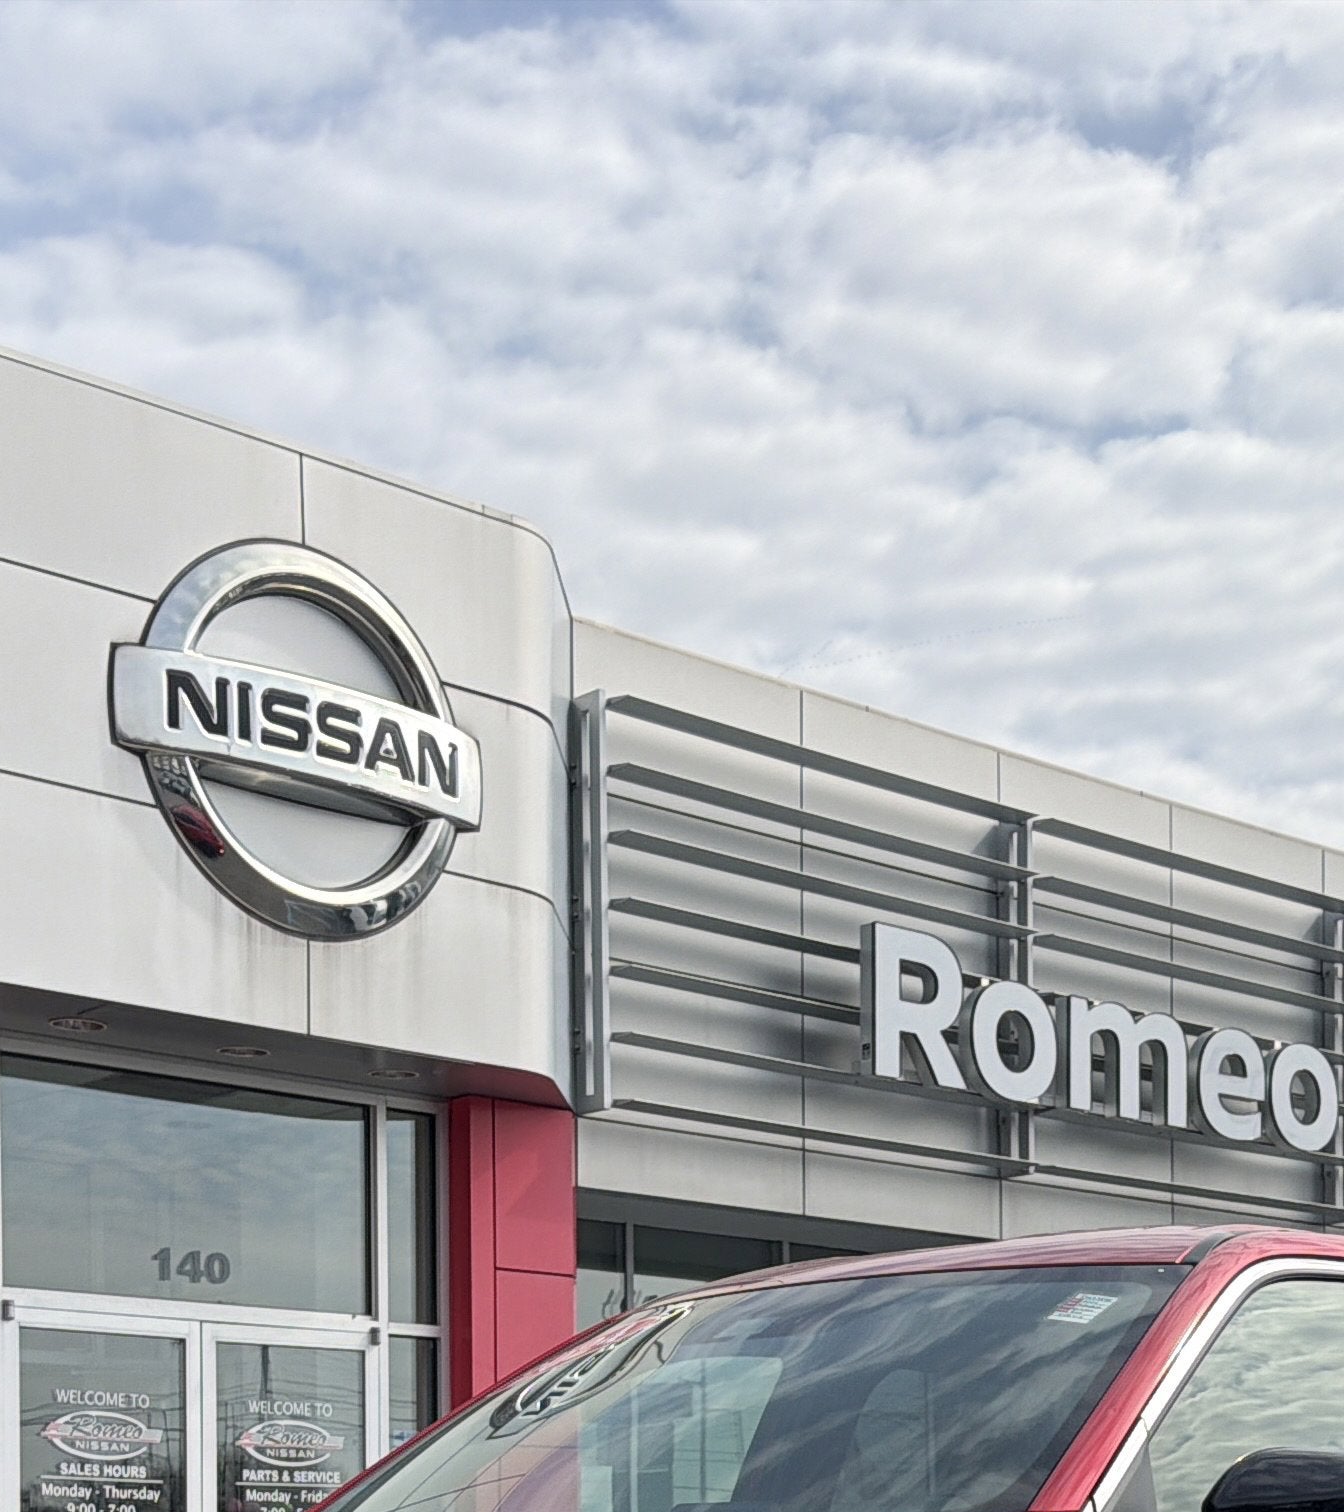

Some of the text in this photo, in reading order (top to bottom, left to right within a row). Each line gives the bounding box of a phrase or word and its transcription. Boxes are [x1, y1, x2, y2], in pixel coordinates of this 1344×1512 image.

[164, 668, 460, 800] NISSAN
[861, 921, 1340, 1153] Romeo
[151, 1247, 231, 1285] 140
[56, 1389, 150, 1409] WELCOME TO
[248, 1400, 333, 1418] WELCOME TO
[68, 1414, 144, 1440] Romeo
[256, 1423, 328, 1447] Romeo
[75, 1440, 130, 1452] NISSAN
[266, 1448, 316, 1459] NISSAN
[60, 1462, 147, 1479] SALES HOURS
[242, 1469, 341, 1484] PARTS & SERVICE
[41, 1482, 93, 1500] Monday
[103, 1484, 161, 1503] Thursday
[246, 1488, 292, 1504] Monday
